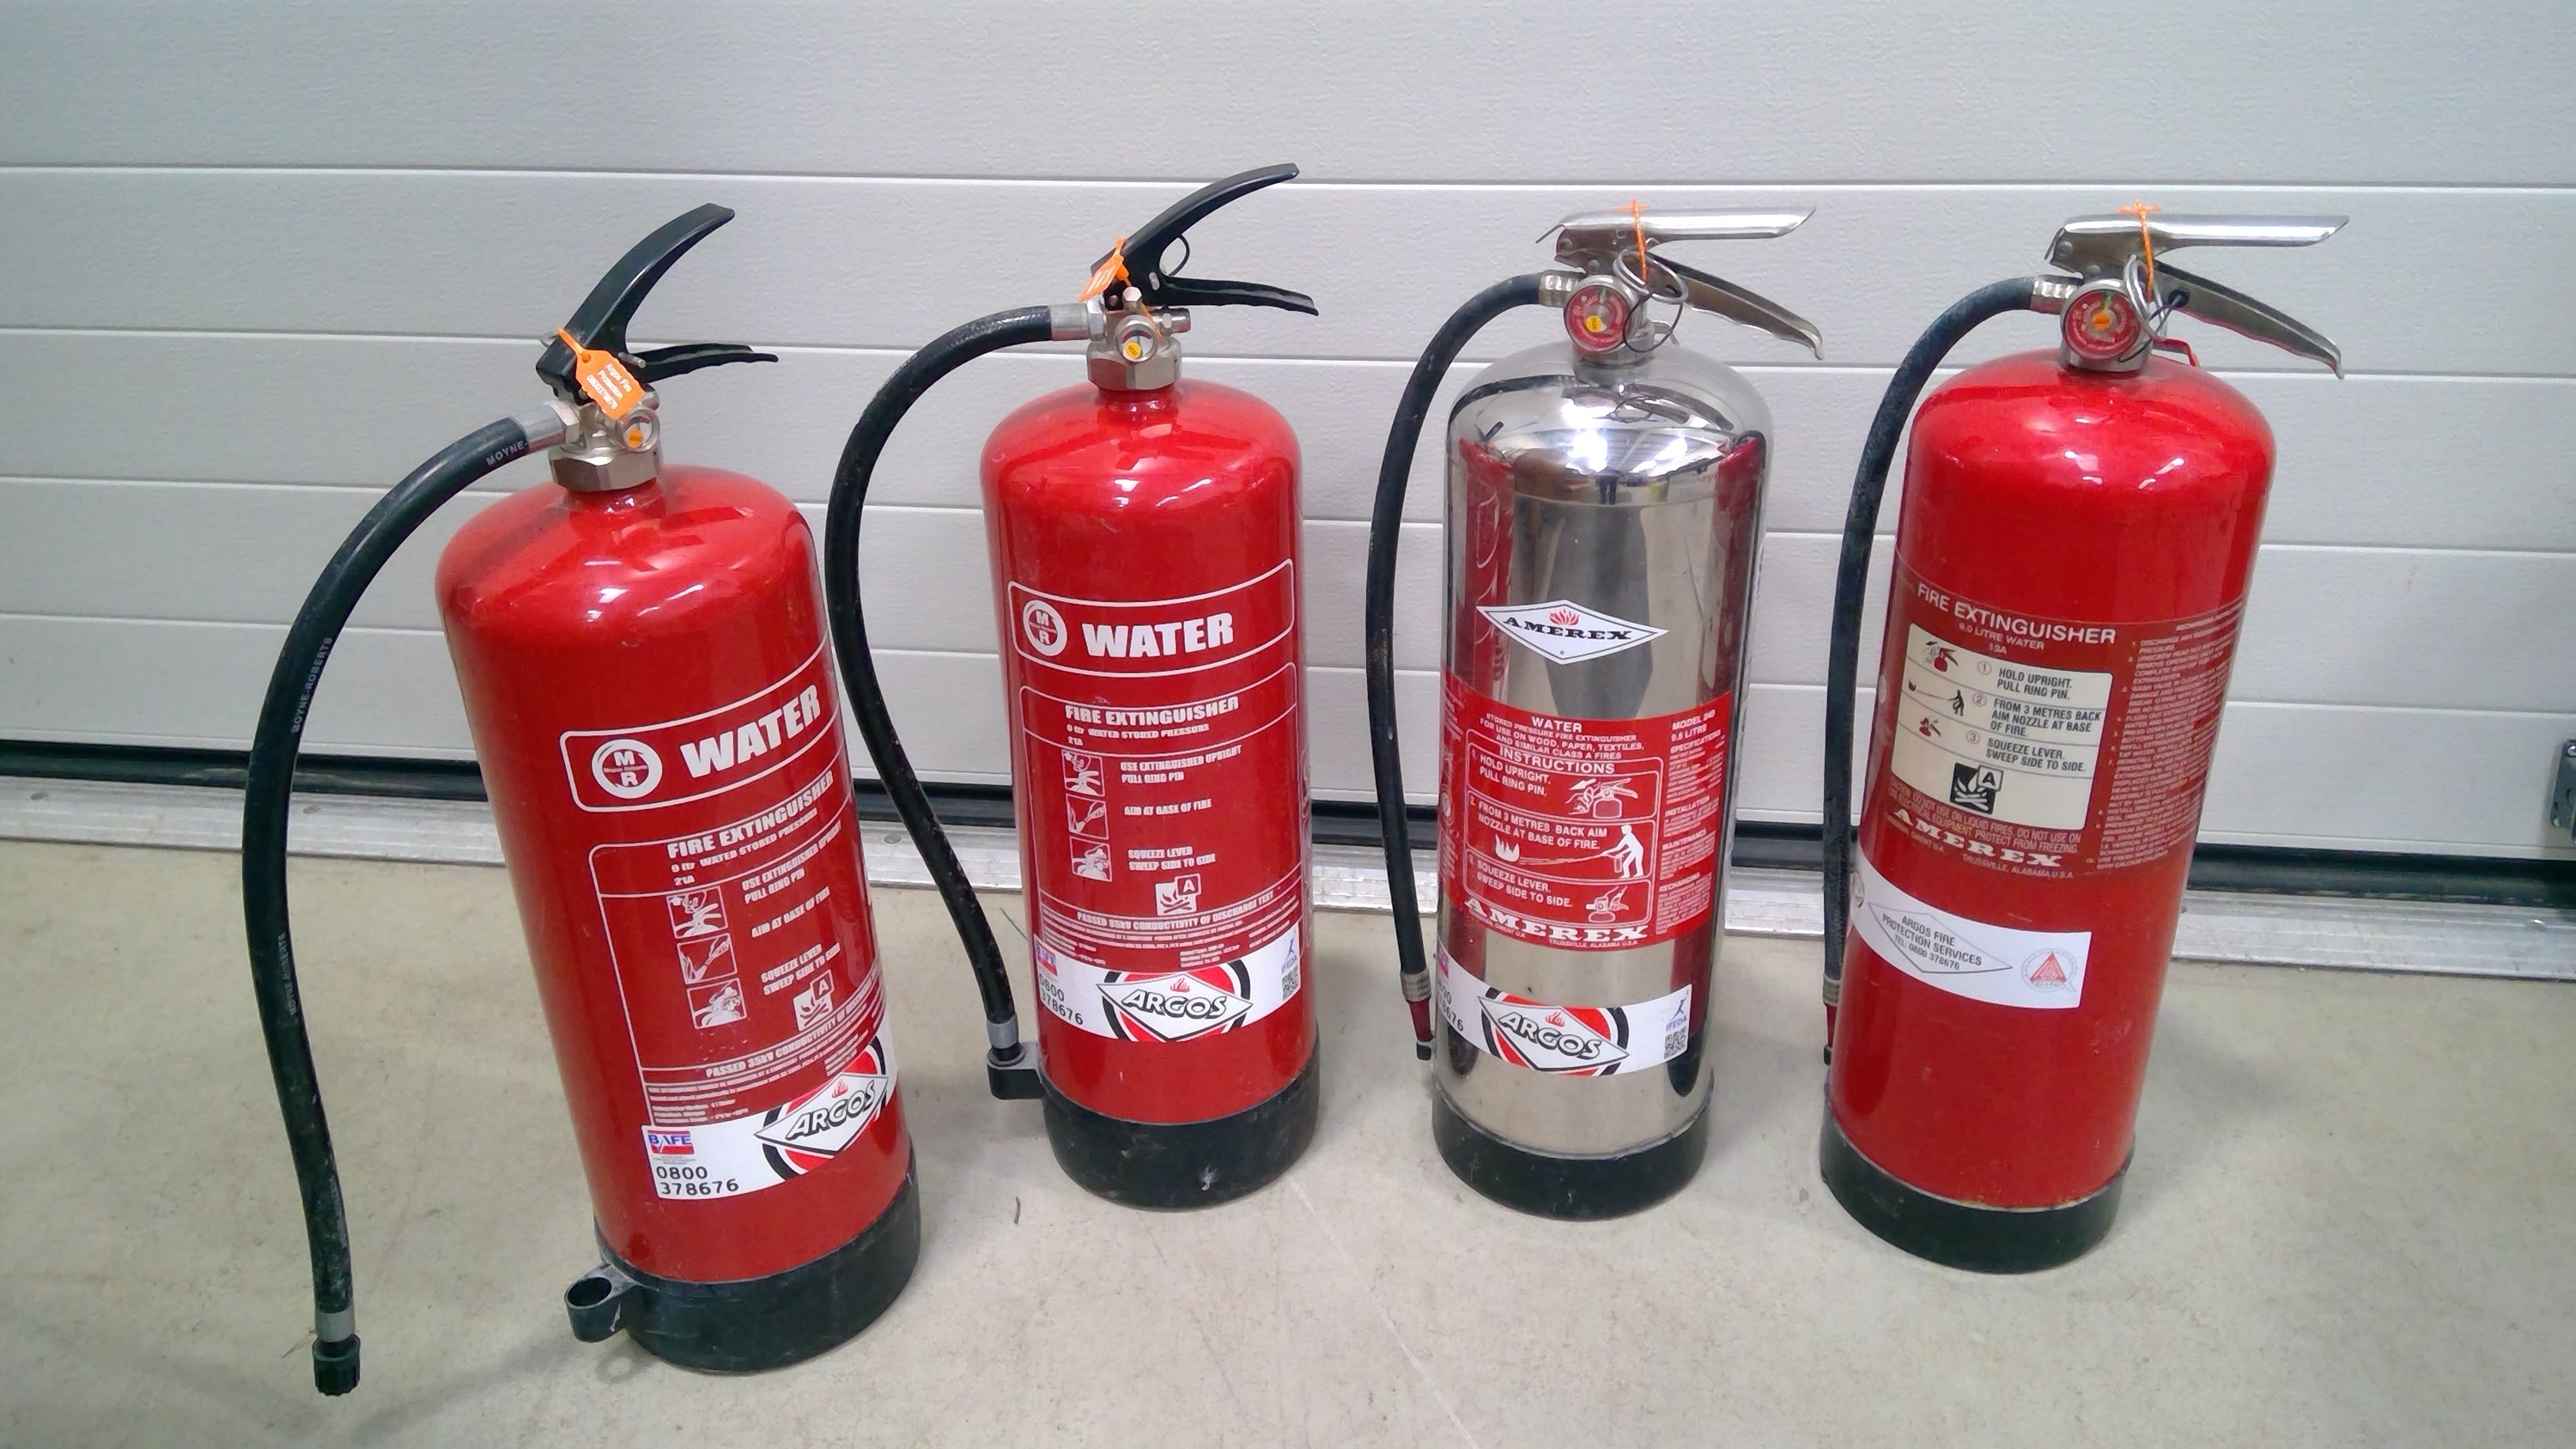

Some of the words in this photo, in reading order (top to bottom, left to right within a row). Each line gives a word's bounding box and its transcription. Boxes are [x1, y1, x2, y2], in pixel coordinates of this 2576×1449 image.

[1917, 583, 1951, 612] FIRE
[1954, 600, 2117, 644] EXTINGUISHER
[1081, 612, 1234, 658] WATER
[1503, 617, 1631, 641] AMEREX
[1975, 626, 2003, 642] LITRE
[2006, 636, 2044, 651] WATER
[1997, 679, 2020, 693] PULL
[2024, 685, 2048, 697] RING
[2050, 689, 2069, 700] PIN.
[1999, 668, 2025, 681] HOLD
[2027, 673, 2072, 689] UPRIGHT.
[1065, 704, 1102, 724] FIRE
[1105, 696, 1239, 726] EXTINGUISHER
[1992, 709, 2009, 722] AIM
[2012, 715, 2048, 728] NOZZLE
[2051, 721, 2064, 730] AT
[2066, 721, 2092, 733] BASE
[1994, 698, 2021, 713] FROM
[2024, 705, 2030, 714] 3
[2032, 706, 2072, 720] METRES
[2075, 711, 2102, 721] BACK
[680, 684, 822, 779] WATER
[1479, 718, 1494, 730] FOR
[1496, 725, 1511, 736] USE
[1513, 732, 1526, 741] ON
[1562, 741, 1595, 752] PAPER,
[1598, 742, 1644, 752] TEXTILES,
[1486, 713, 1513, 728] STORED
[1514, 723, 1554, 738] PRESSURE
[1555, 732, 1573, 740] FIRE
[1531, 715, 1583, 734] WATER
[1672, 715, 1703, 731] MODEL
[1685, 723, 1707, 739] LITRE
[1990, 721, 2003, 731] OF
[613, 751, 635, 766] M
[1120, 762, 1138, 771] USE
[1206, 745, 1242, 764] UPRIGHT
[1496, 734, 1513, 746] AND
[1515, 740, 1550, 755] SIMILAR
[1552, 748, 1583, 759] CLASS
[1988, 738, 2030, 756] SQUEEZE
[1479, 754, 1504, 771] HOLD
[1505, 765, 1552, 785] UPRIGHT.
[1499, 745, 1615, 775] INSTRUCTIONS
[1985, 749, 2019, 764] SWEEP
[2021, 757, 2043, 768] SIDE
[2047, 759, 2059, 770] TO
[621, 771, 639, 786] R
[1479, 766, 1500, 782] PULL
[1502, 776, 1525, 791] RING
[1528, 785, 1547, 796] PIN.
[1982, 771, 1996, 786] A
[667, 835, 715, 859] FIRE
[719, 770, 834, 847] EXTINGUISHER
[1180, 801, 1192, 813] OF
[1193, 799, 1212, 810] FIRE
[1479, 801, 1502, 819] FROM
[1504, 812, 1509, 822] 3
[1511, 814, 1550, 832] METRES
[1555, 825, 1584, 837] BACK
[1588, 827, 1607, 837] AIM
[1479, 813, 1511, 835] NOZZLE
[1513, 828, 1525, 839] AT
[1528, 831, 1554, 846] BASE
[1557, 837, 1571, 847] OF
[1574, 839, 1600, 849] FIRE.
[1923, 797, 1936, 810] NOT
[1936, 805, 1951, 817] USE
[1951, 811, 1963, 823] ON
[1964, 813, 1990, 831] LIQUID
[2017, 828, 2030, 838] DO
[2031, 830, 2050, 841] NOT
[2050, 832, 2068, 843] USE
[2069, 833, 2081, 843] ON
[738, 834, 777, 855] STORED
[1893, 808, 2063, 868] AMEREX
[1975, 829, 2012, 847] PROTECT
[2013, 837, 2037, 850] FROM
[1183, 857, 1194, 868] TO
[742, 875, 761, 891] USE
[1182, 880, 1195, 892] A
[1477, 860, 1516, 884] SQUEEZE
[1517, 876, 1551, 892] LEVER.
[1477, 871, 1504, 891] SWEEP
[1506, 885, 1528, 899] SIDE
[1529, 891, 1544, 903] TO
[1546, 895, 1573, 908] SIDE.
[1464, 897, 1649, 942] AMEREX
[1902, 916, 1931, 937] ARGOS
[1934, 931, 1956, 947] FIRE
[1882, 913, 1930, 949] PROTECTION
[1933, 943, 1983, 966] SERVICES
[1909, 944, 1927, 958] 0800
[819, 979, 829, 996] A
[1039, 972, 1064, 1002] 0800
[1041, 987, 1083, 1026] 378676
[1121, 989, 1228, 1020] ARGOS
[1666, 1015, 1687, 1031] IFEDA
[1498, 1011, 1604, 1061] ARGOS
[785, 1080, 876, 1141] ARGOS
[656, 1166, 708, 1180] 0800
[660, 1178, 739, 1196] 378676
